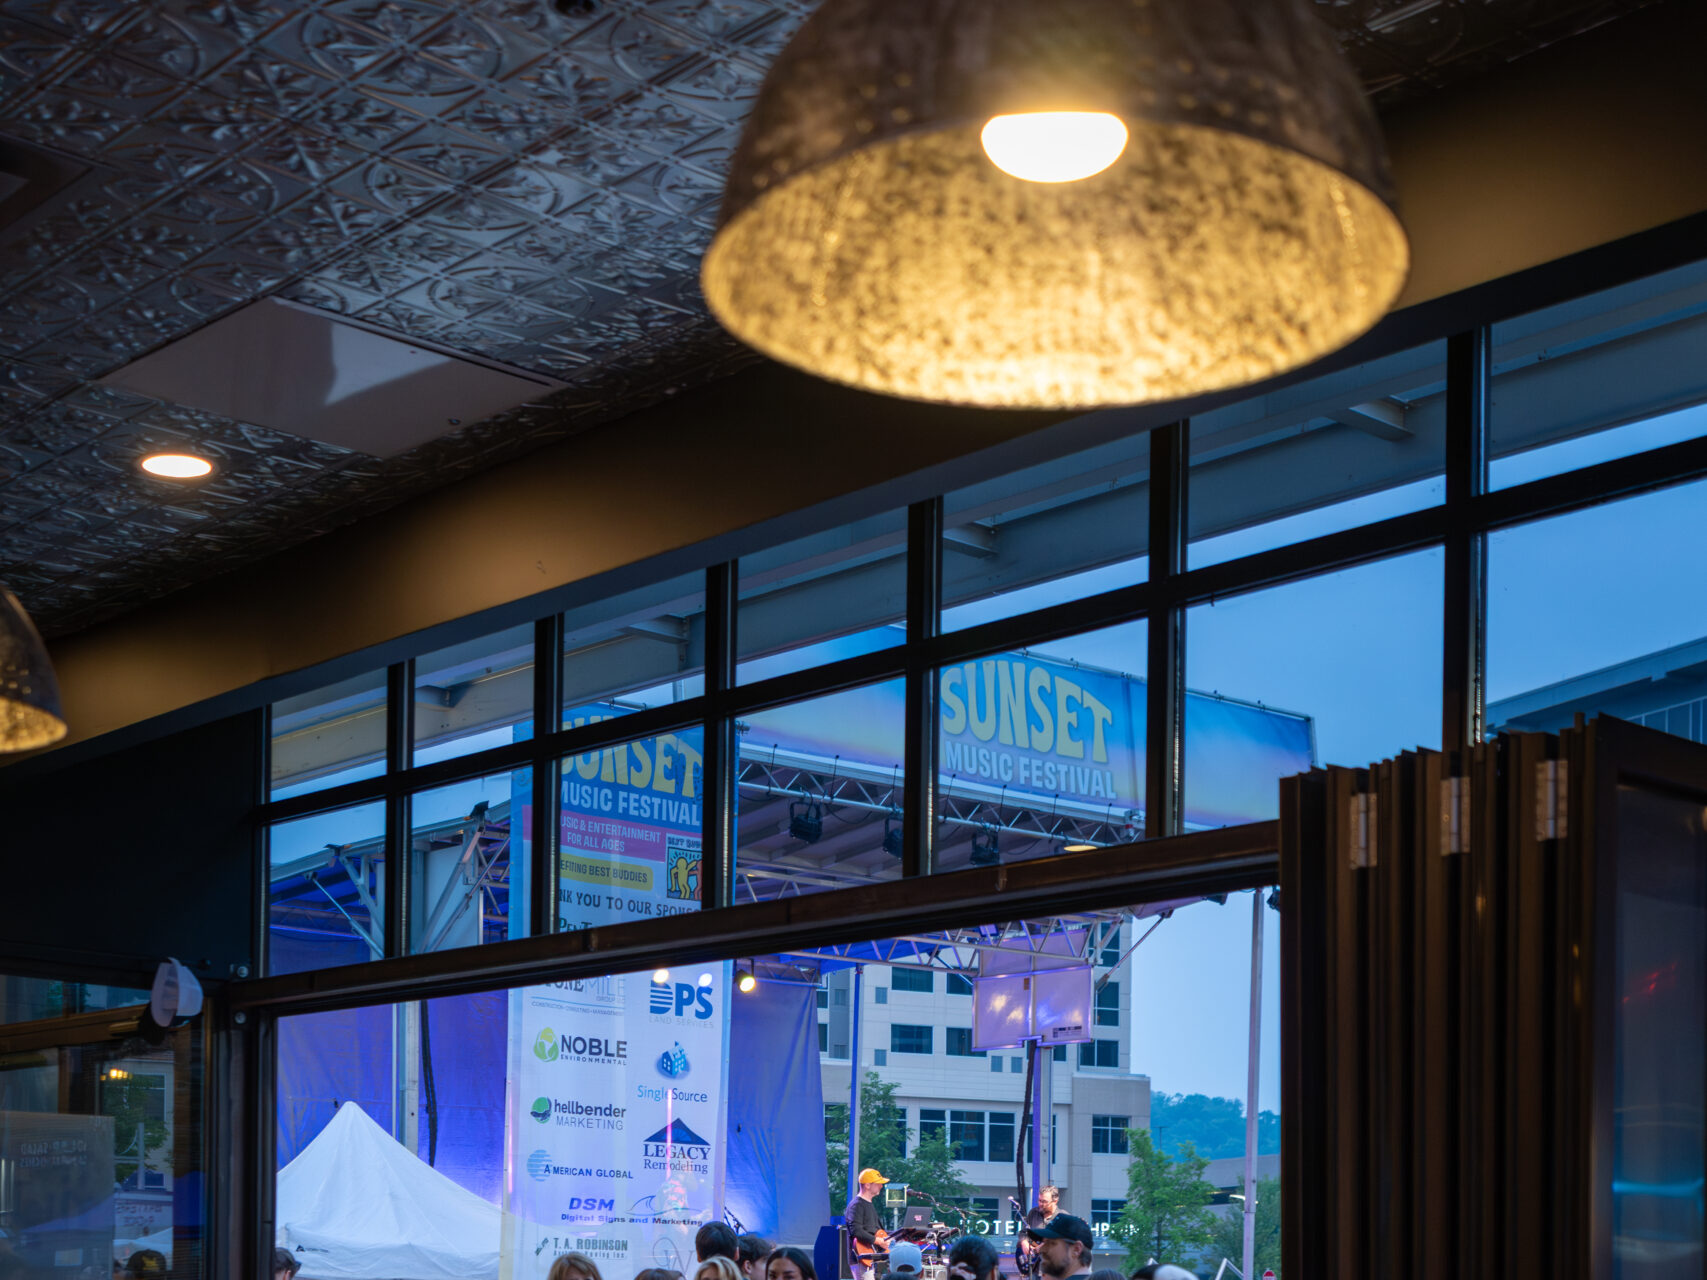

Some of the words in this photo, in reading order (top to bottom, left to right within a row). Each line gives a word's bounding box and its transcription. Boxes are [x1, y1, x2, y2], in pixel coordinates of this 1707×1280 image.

[941, 660, 1112, 763] SUNSET
[945, 741, 1013, 782] MUSIC
[1018, 756, 1117, 800] FESTIVAL
[617, 791, 700, 826] FESTIVAL
[561, 815, 579, 830] USIC
[580, 820, 587, 832] &
[588, 822, 661, 843] ENTERTAINMENT
[567, 832, 582, 846] FOR
[583, 835, 600, 849] ALL
[601, 838, 625, 852] AGES
[561, 859, 587, 875] EFITING
[588, 864, 610, 879] BEST
[612, 868, 648, 883] BUDDIES
[576, 892, 601, 909] YOU
[606, 896, 623, 910] TO
[627, 901, 652, 915] OUR
[561, 1034, 627, 1059] NOBLE
[560, 1055, 627, 1066] ENVIRONMENTAL
[554, 1099, 627, 1118] hellbender
[556, 1115, 624, 1131] MARKETING
[643, 1143, 712, 1160] LEGACY
[544, 1164, 592, 1177] AMERICAN
[596, 1169, 634, 1180] GLOBAL
[643, 1159, 709, 1175] Remodeling
[568, 1197, 615, 1212] DSM
[561, 1213, 595, 1223] Digital
[598, 1214, 626, 1225] Signs
[629, 1216, 649, 1225] and
[652, 1216, 703, 1228] Marketing
[553, 1238, 562, 1249] T.
[563, 1238, 573, 1250] A.
[576, 1239, 629, 1252] ROBINSON
